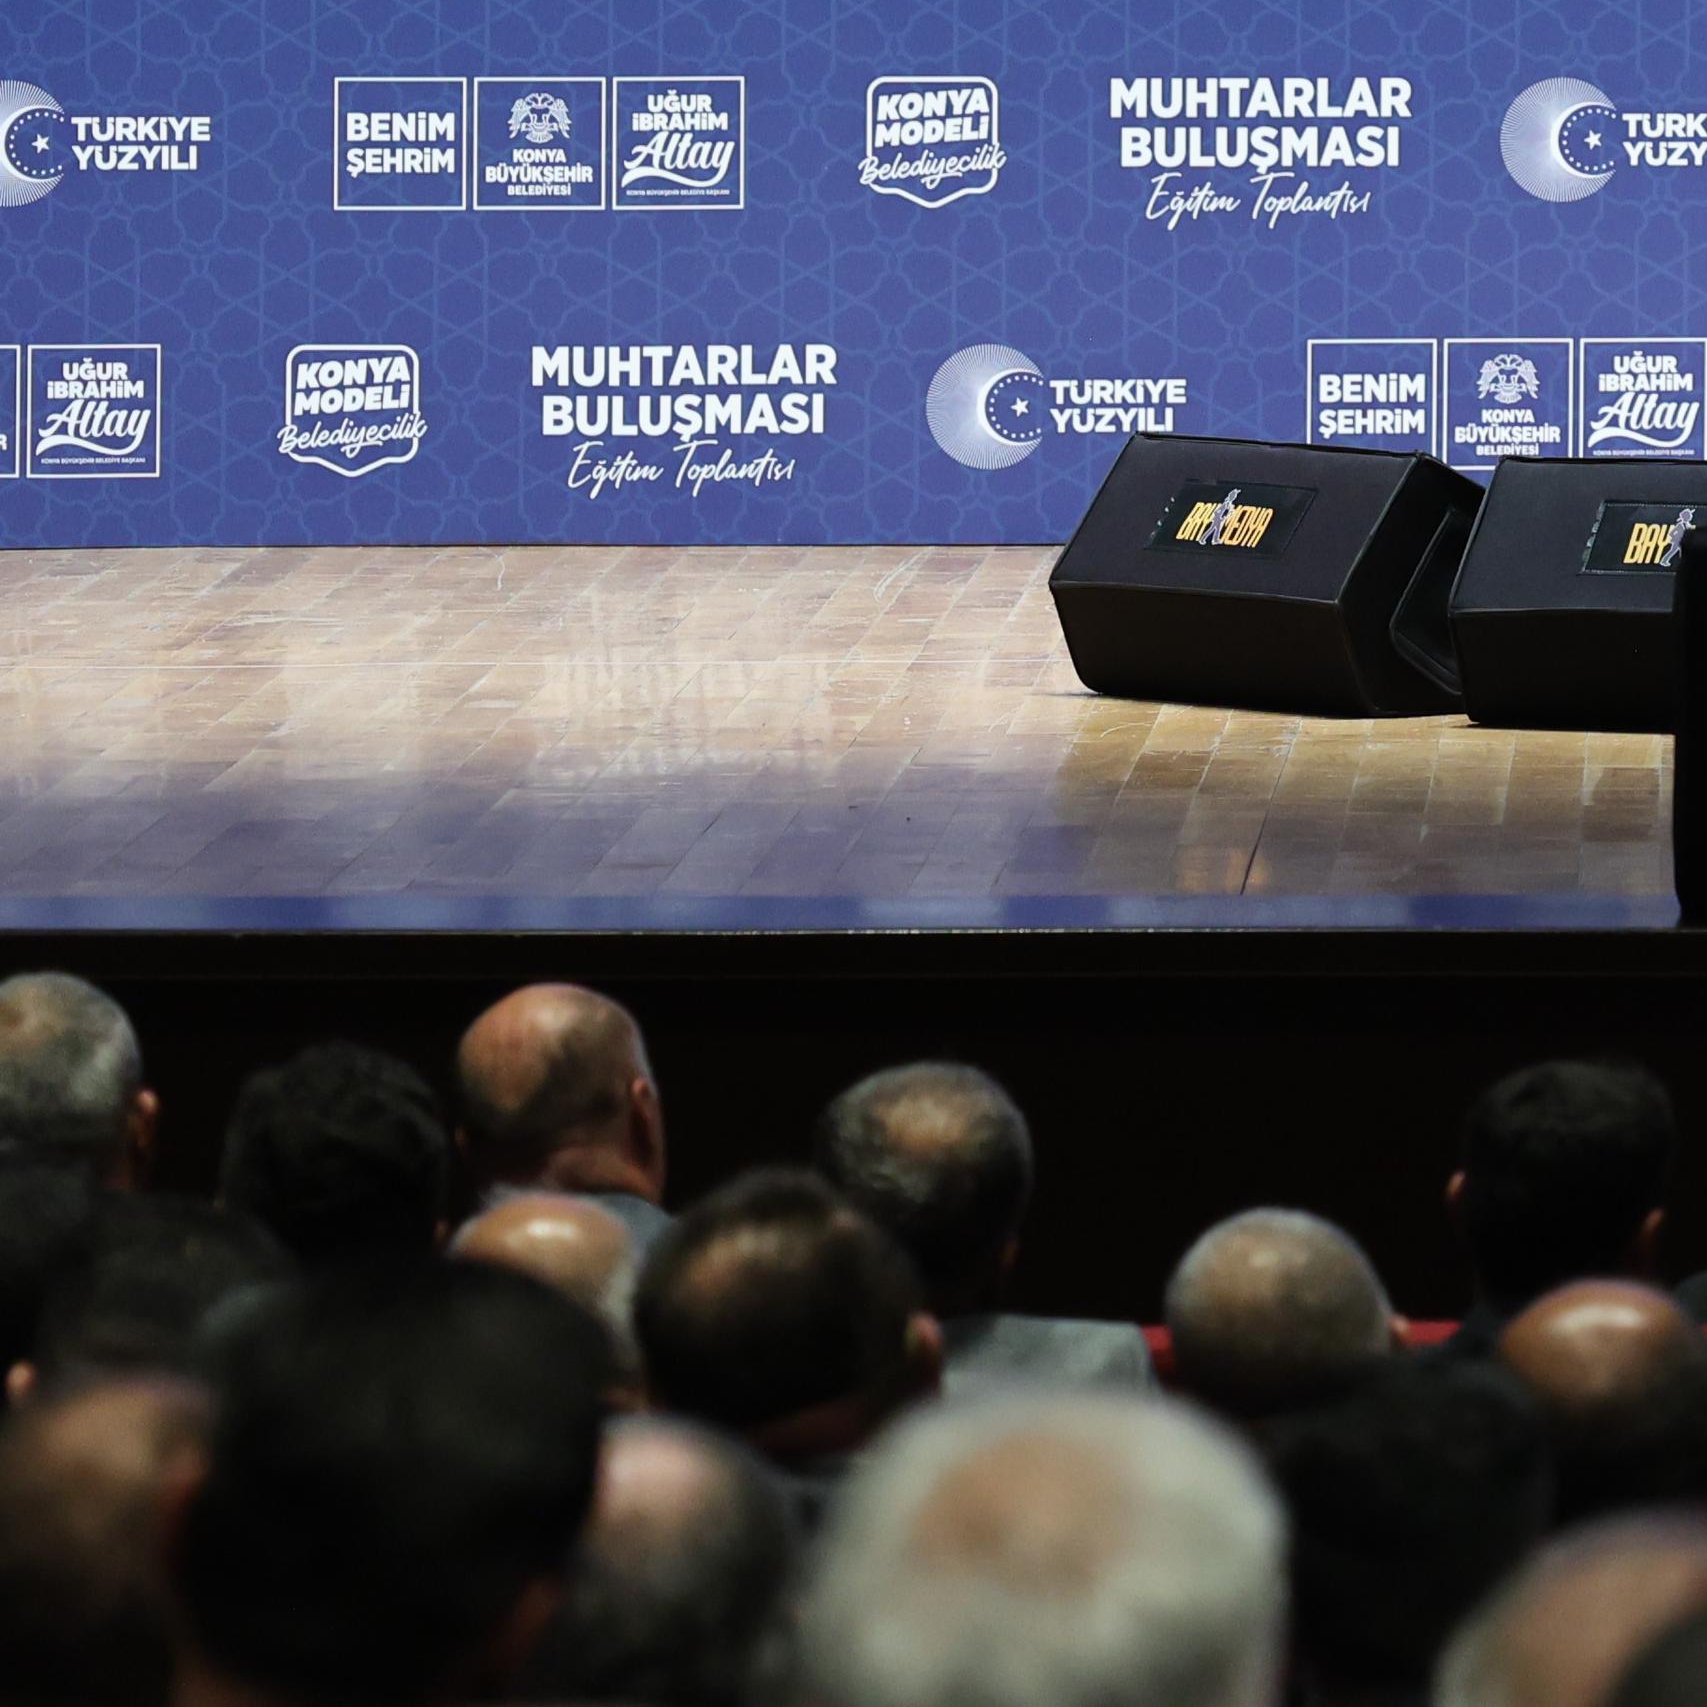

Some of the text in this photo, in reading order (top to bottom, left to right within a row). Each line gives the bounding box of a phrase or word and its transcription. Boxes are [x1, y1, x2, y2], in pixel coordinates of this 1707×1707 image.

[876, 88, 990, 121] KONYA
[1111, 78, 1411, 119] MUHTARLAR
[875, 116, 990, 148] MODELİ
[1122, 127, 1399, 175] BULUŞMASI
[859, 143, 1007, 191] Belediyecilik
[1147, 171, 1371, 230] Eğitim Toplantısı
[63, 357, 128, 381] UĞUR
[36, 399, 151, 456] Altay
